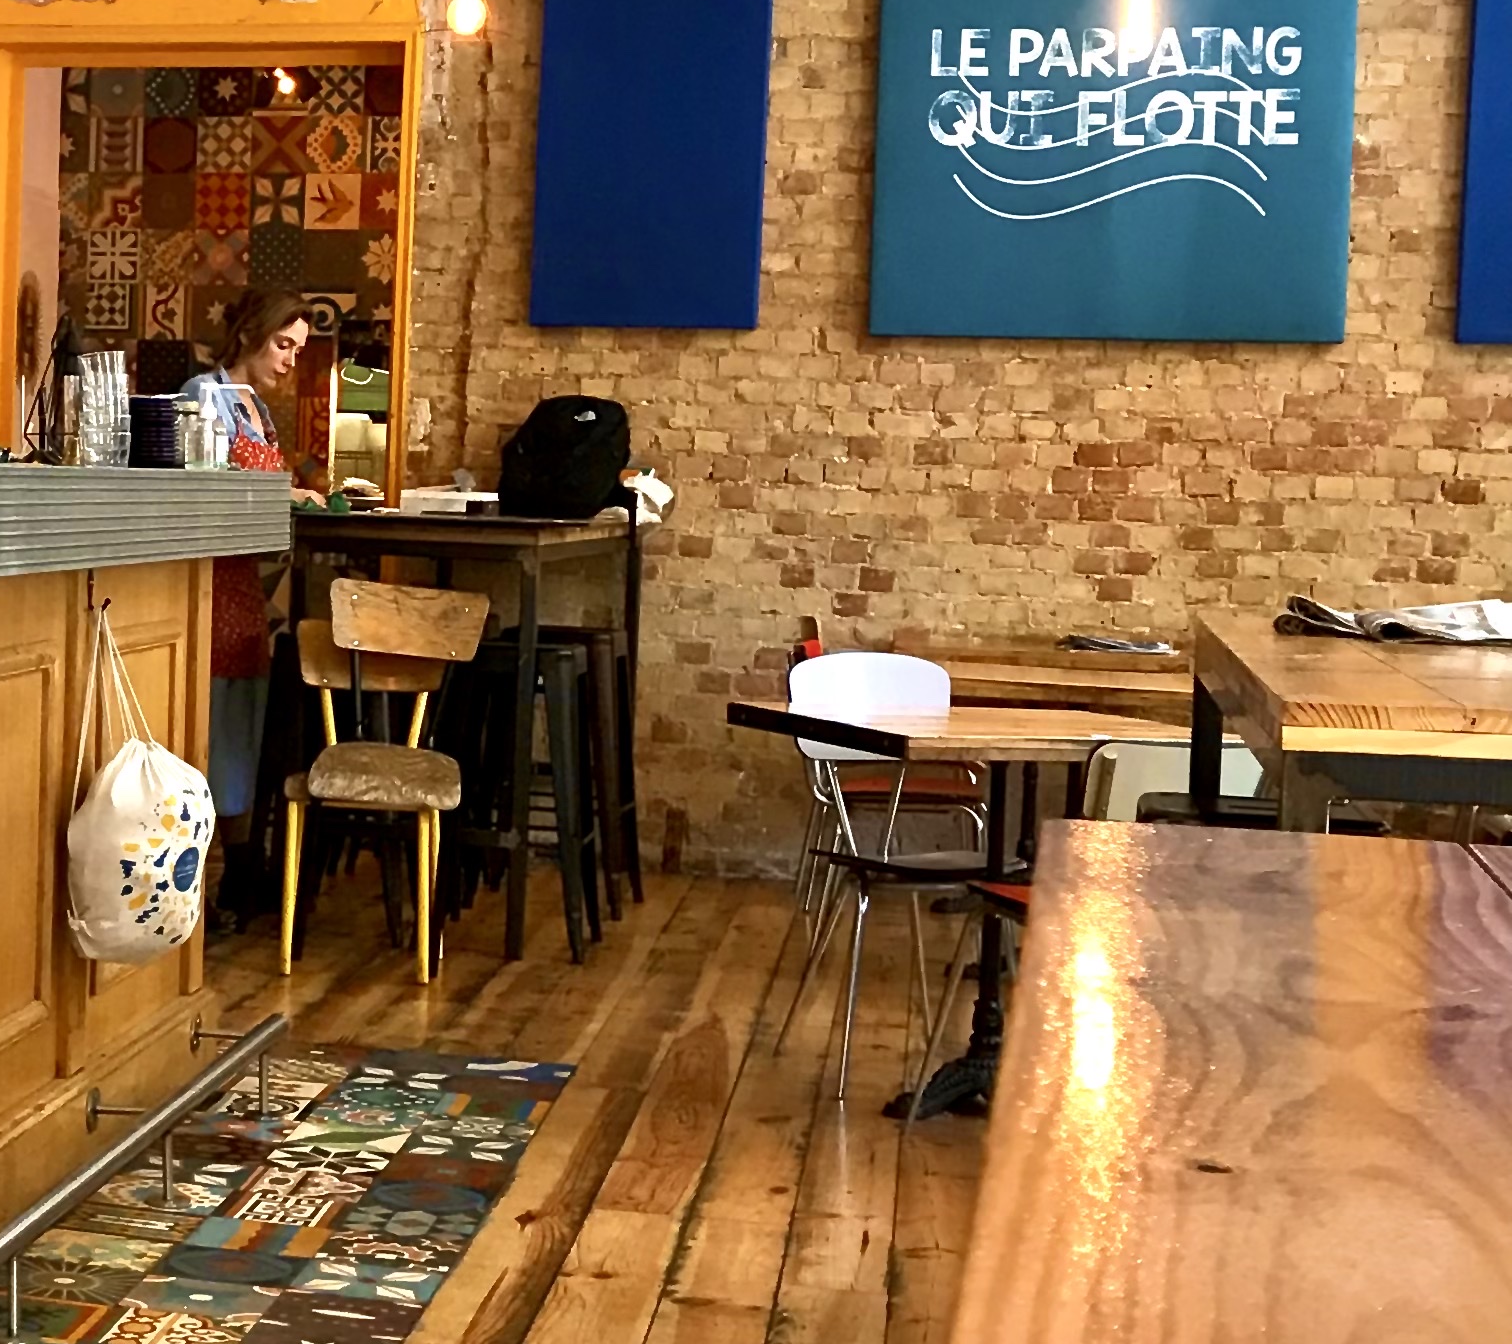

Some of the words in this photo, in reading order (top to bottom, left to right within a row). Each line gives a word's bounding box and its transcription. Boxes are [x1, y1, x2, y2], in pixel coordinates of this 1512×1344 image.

[930, 28, 990, 77] LE
[928, 89, 1054, 148] QUI
[1076, 88, 1300, 147] FLOTTE
